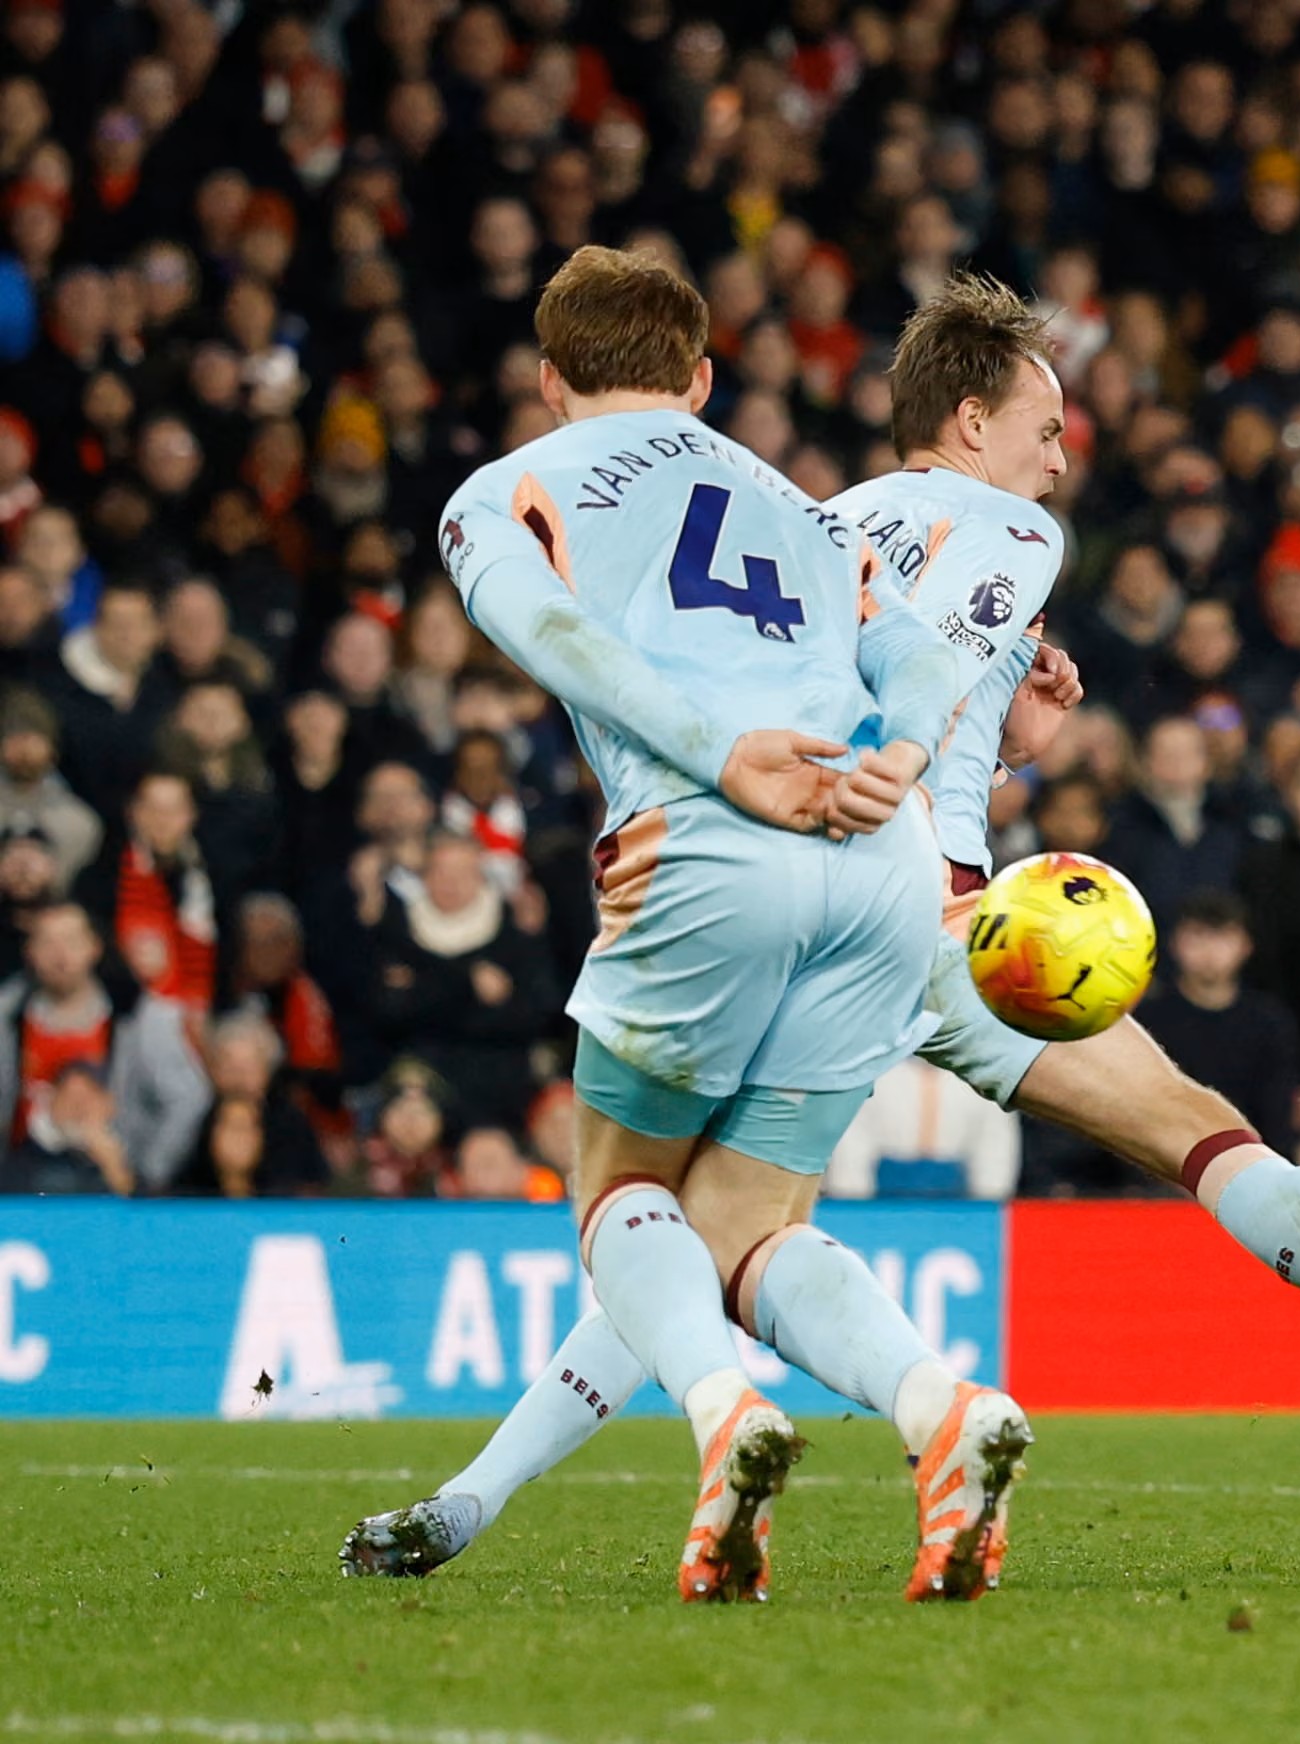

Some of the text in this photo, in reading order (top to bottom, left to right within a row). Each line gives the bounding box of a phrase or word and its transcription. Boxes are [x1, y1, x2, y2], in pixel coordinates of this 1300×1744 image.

[576, 450, 653, 510] VAN
[646, 432, 737, 465] DEN
[668, 482, 806, 643] 4
[625, 1211, 684, 1230] BEE
[559, 1368, 610, 1419] BEES
